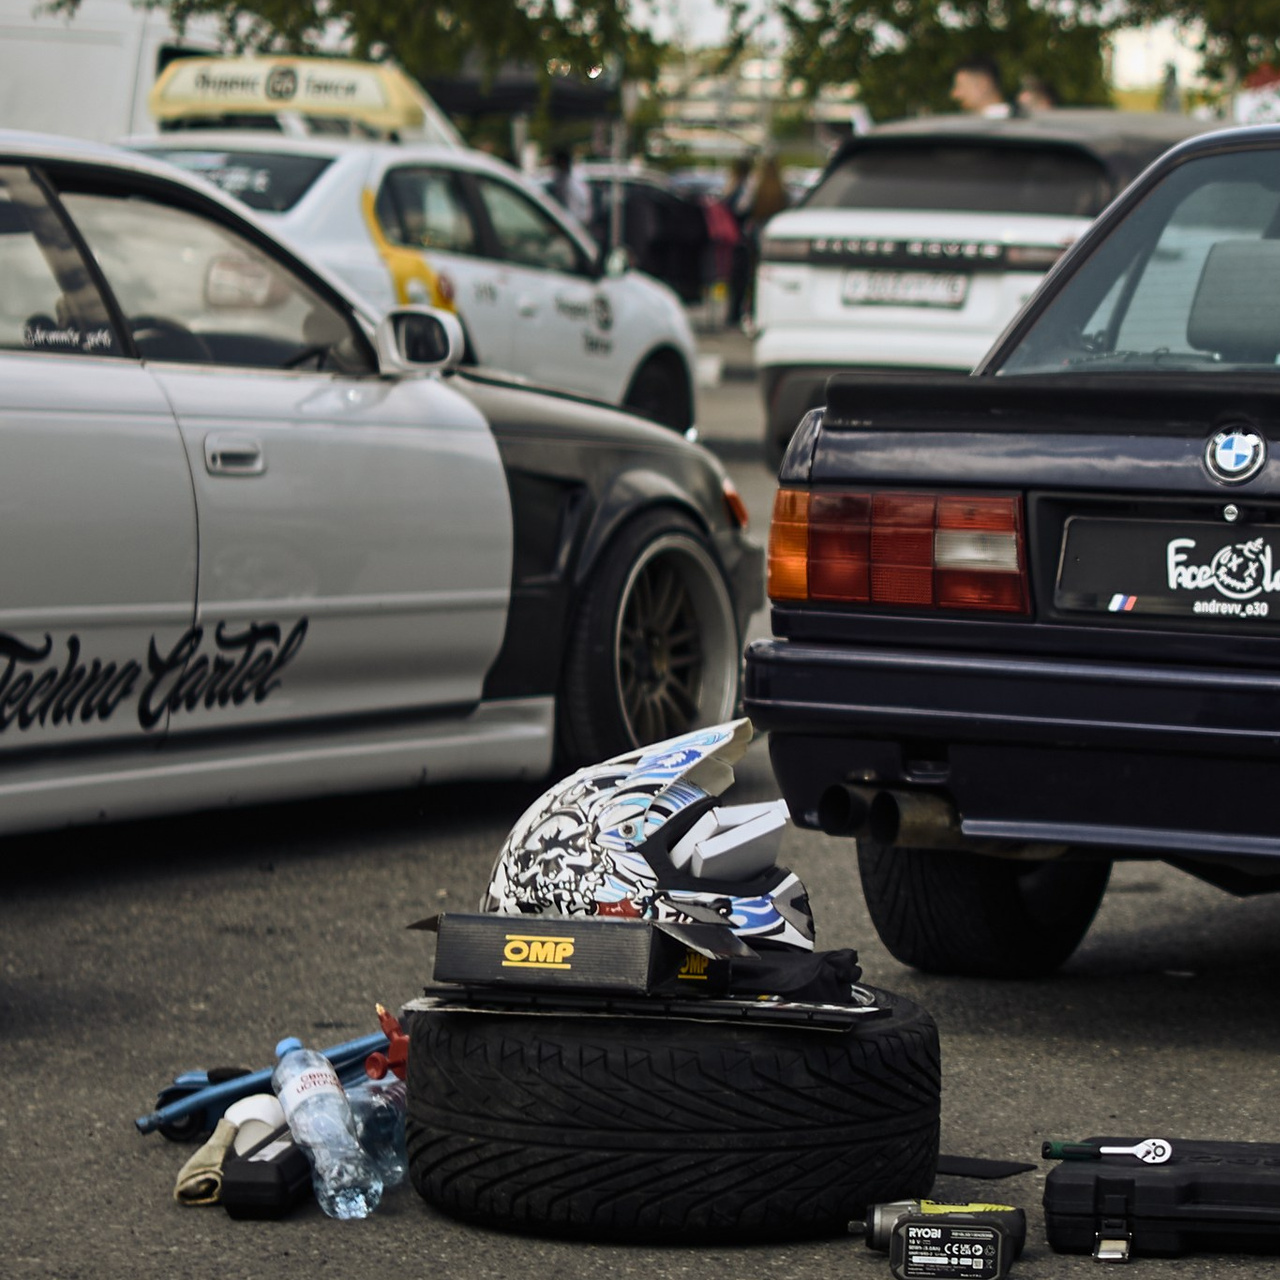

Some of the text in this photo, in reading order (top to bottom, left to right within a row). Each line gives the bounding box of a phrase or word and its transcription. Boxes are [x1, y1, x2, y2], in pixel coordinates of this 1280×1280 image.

[1193, 600, 1269, 617] andrevv_e30
[0, 616, 309, 734] Techno Cartel
[503, 940, 575, 963] OMP
[909, 1228, 942, 1238] RYOBI
